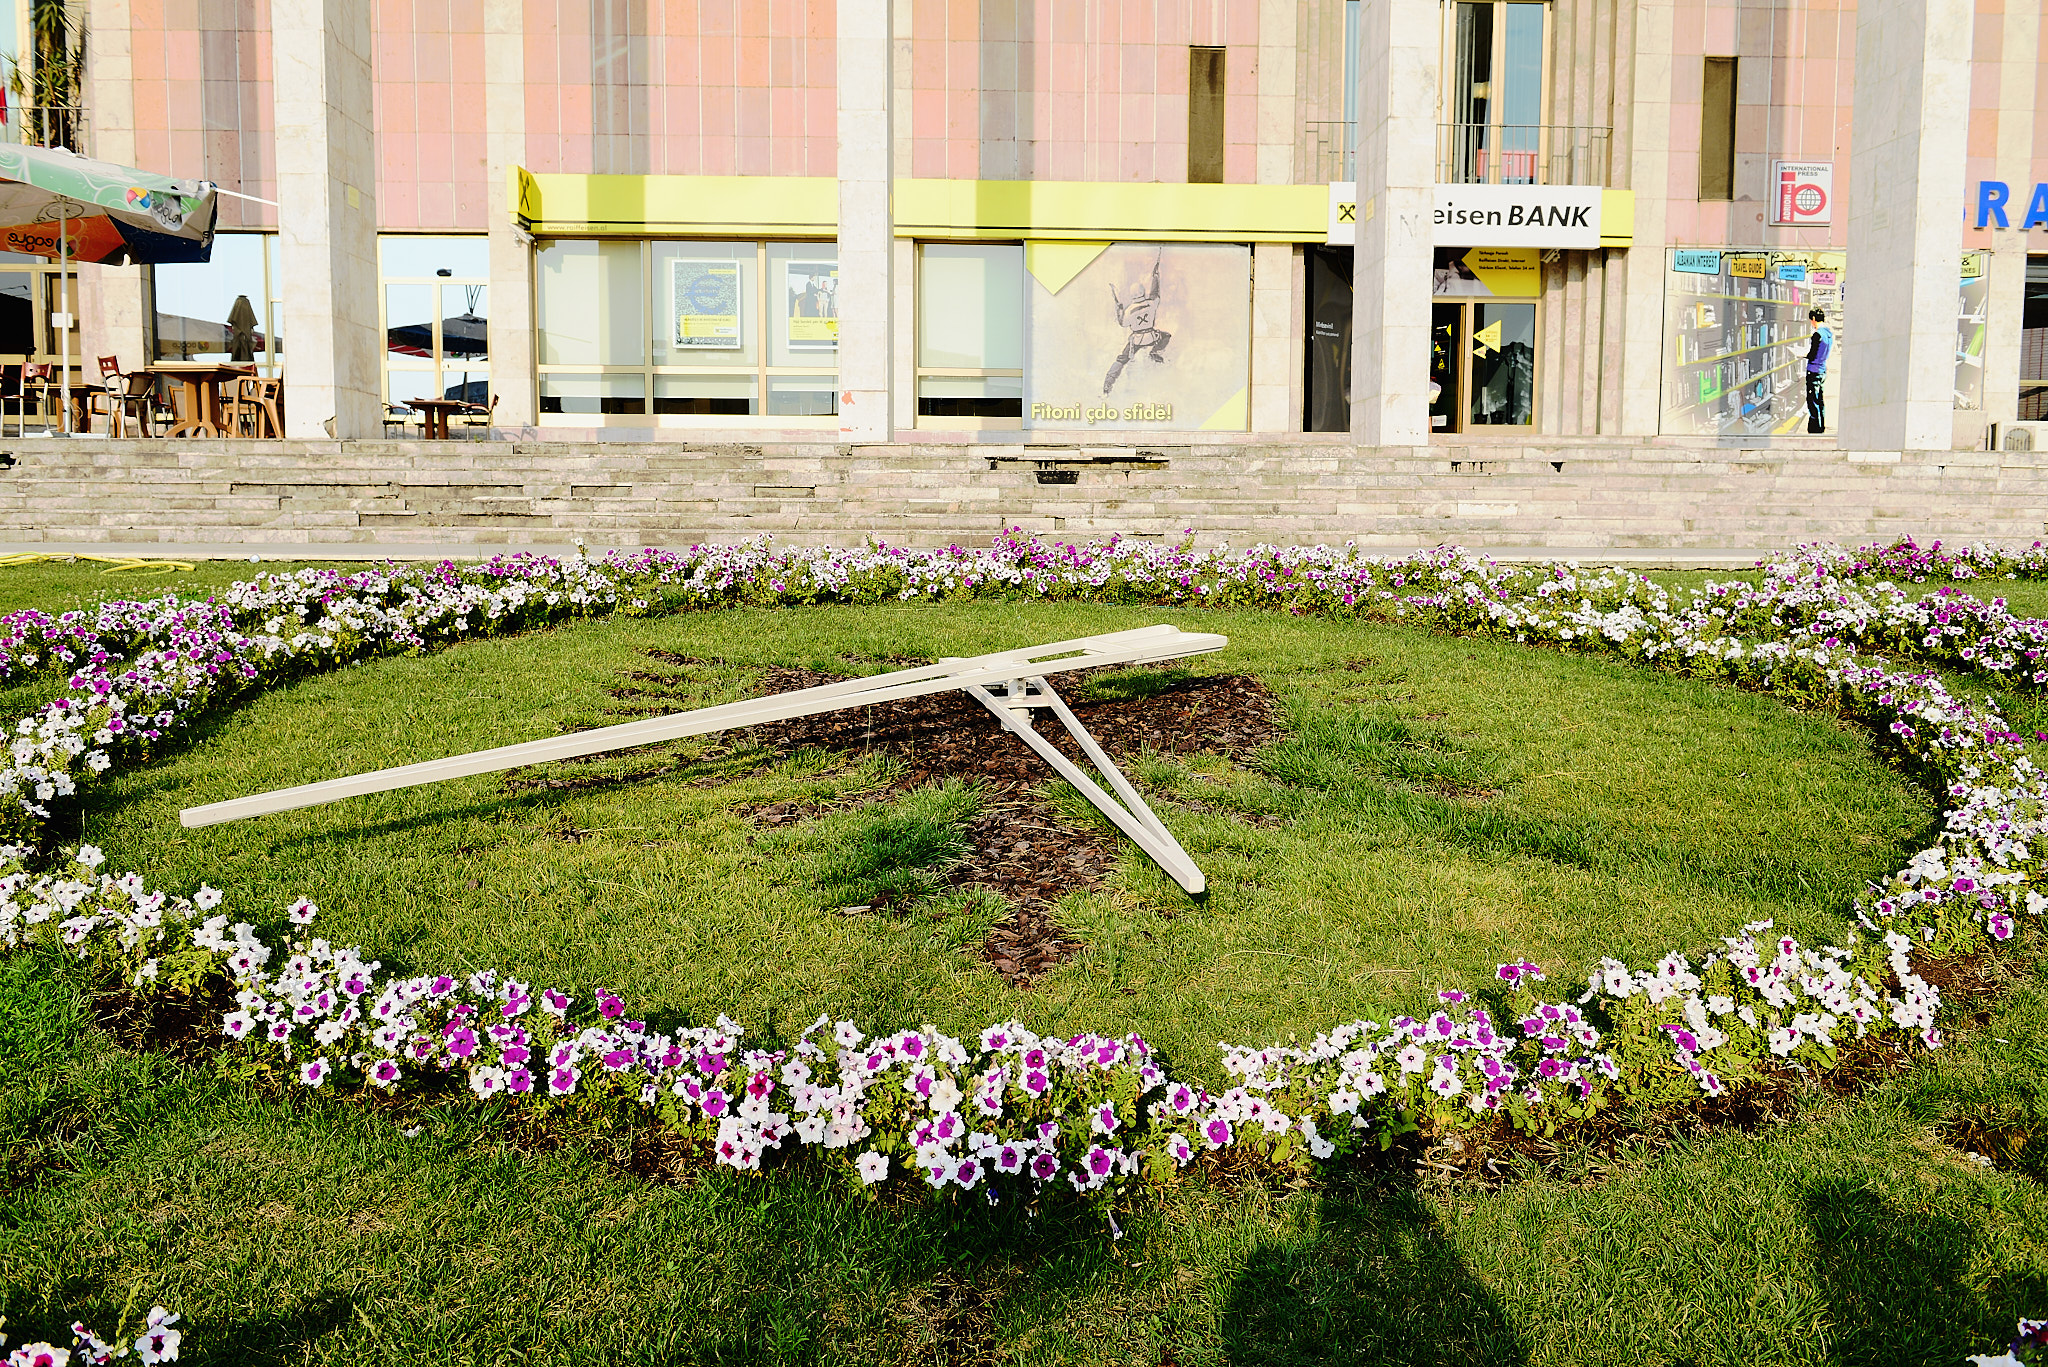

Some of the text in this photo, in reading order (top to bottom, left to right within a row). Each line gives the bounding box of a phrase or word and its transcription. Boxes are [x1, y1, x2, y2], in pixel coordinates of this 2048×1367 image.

[1507, 204, 1592, 228] BANK
[1782, 194, 1791, 220] ADRION
[1963, 181, 2048, 229] RA
[1677, 255, 1717, 268] ALBANIAN INTEREST
[1733, 262, 1762, 274] TRAVEL GUIDE
[1031, 402, 1173, 424] Fitoni çdo sfidë!
